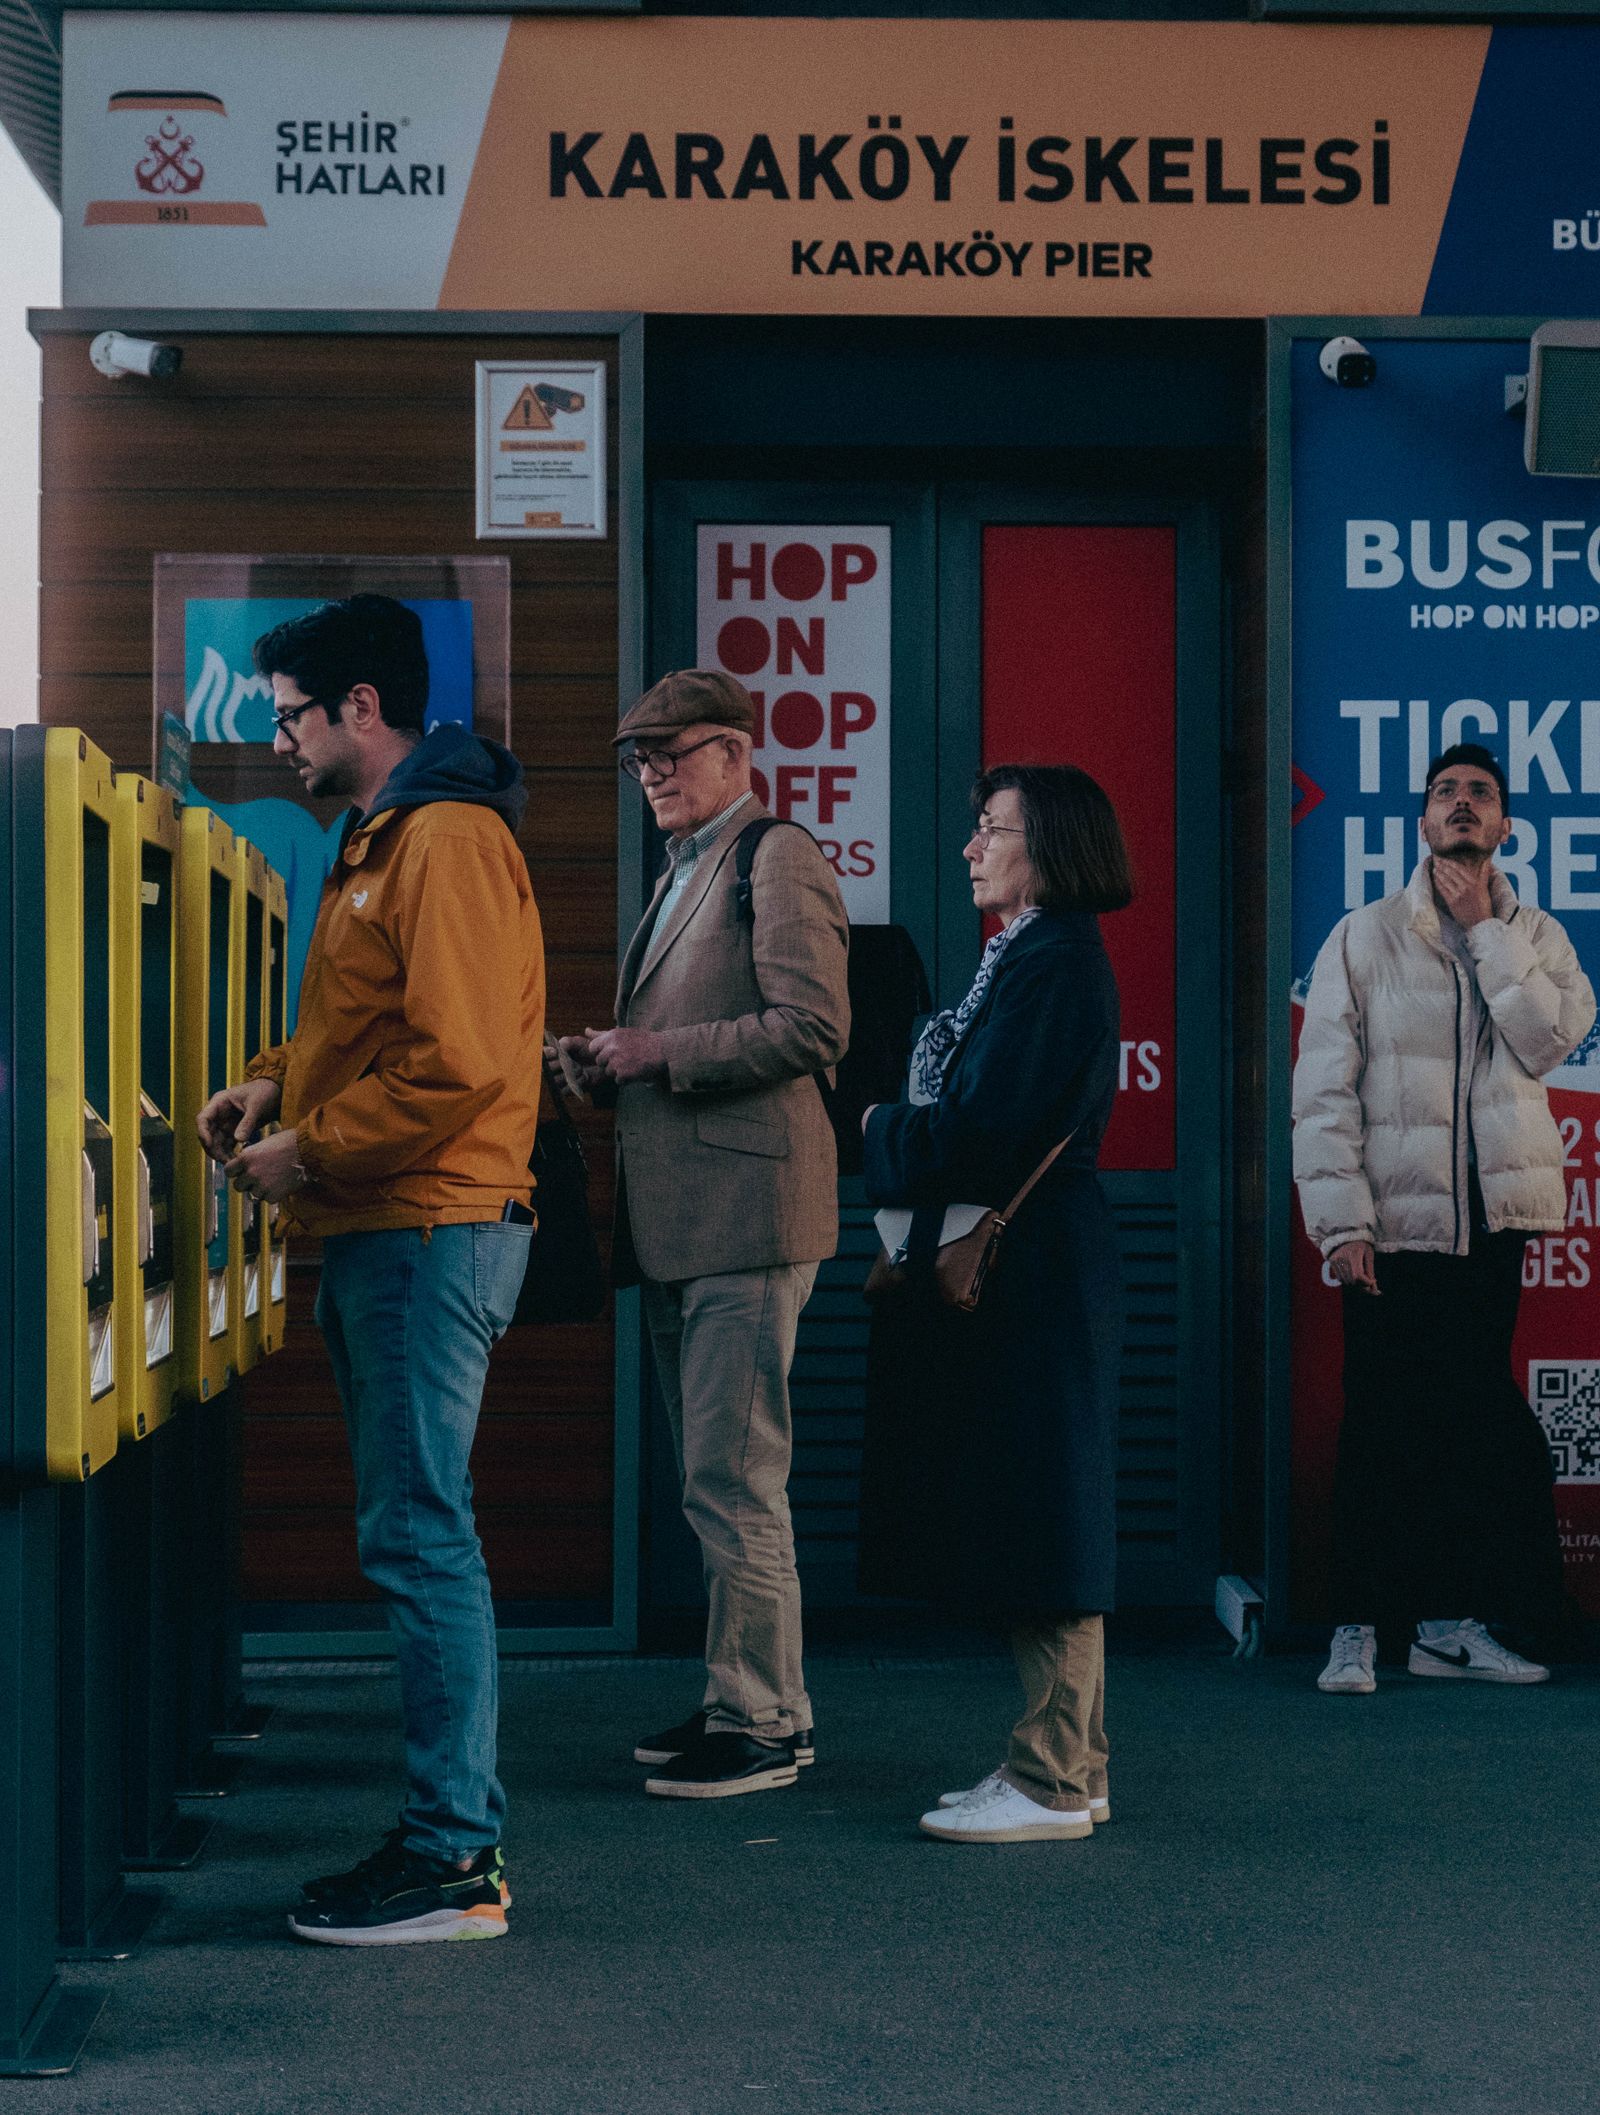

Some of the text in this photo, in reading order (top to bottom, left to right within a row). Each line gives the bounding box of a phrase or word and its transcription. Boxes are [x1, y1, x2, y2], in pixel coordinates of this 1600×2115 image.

[276, 111, 397, 159] ŞEHİR
[549, 115, 1390, 206] KARAKÖY İSKELESİ
[276, 162, 445, 196] HATLARI
[156, 206, 189, 223] 1851
[791, 230, 1153, 278] KARAKÖY PIER
[716, 541, 878, 602] HOP
[1345, 519, 1600, 590] BUSF
[716, 616, 825, 676] ON
[1410, 604, 1600, 629] HOP ON HOP
[752, 690, 877, 750] OP
[750, 764, 857, 824] FF
